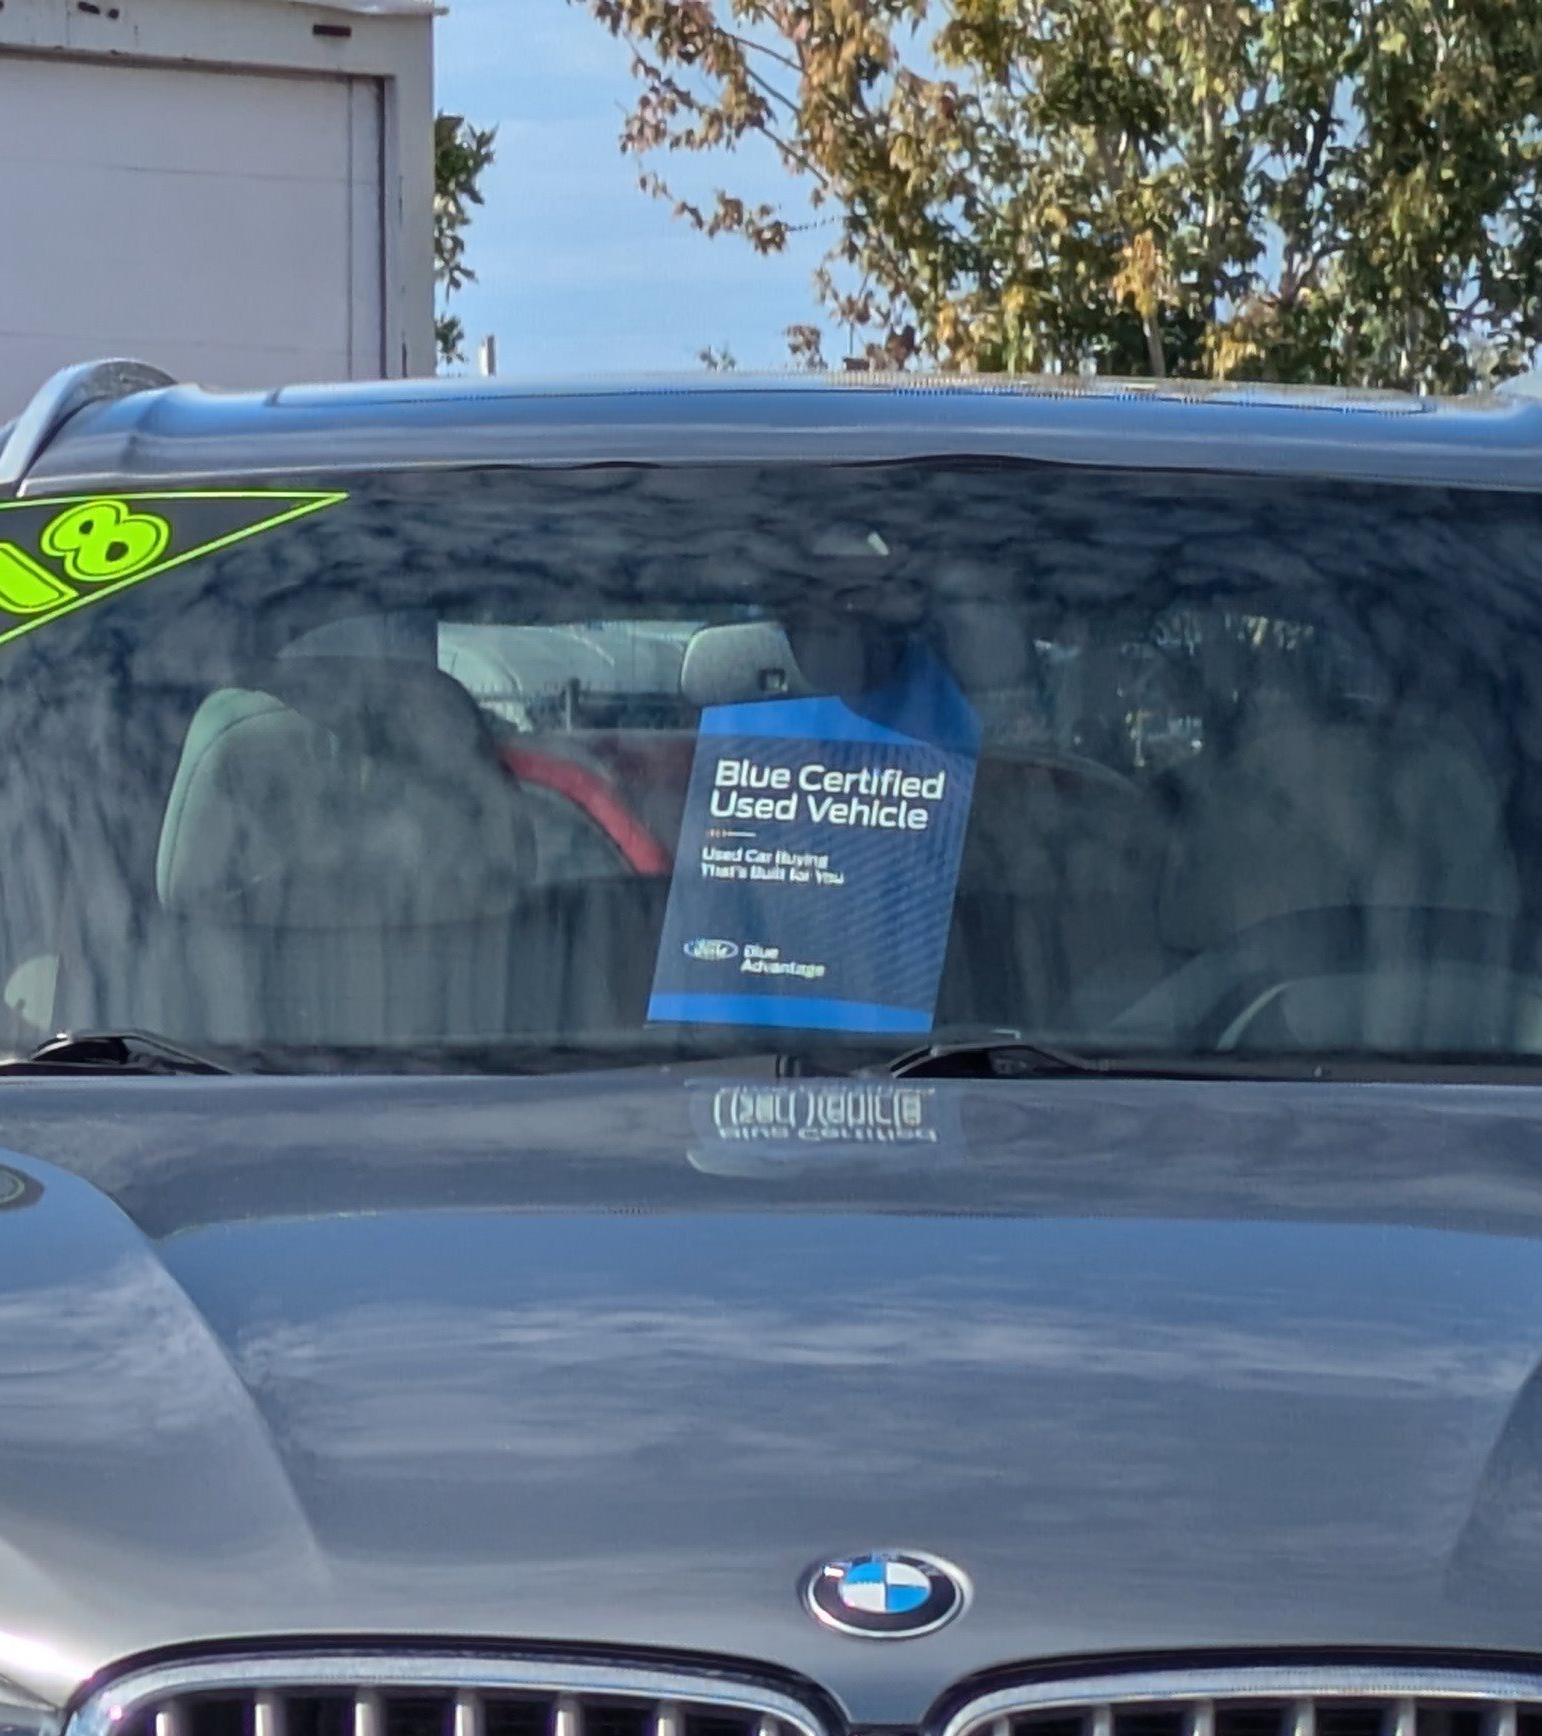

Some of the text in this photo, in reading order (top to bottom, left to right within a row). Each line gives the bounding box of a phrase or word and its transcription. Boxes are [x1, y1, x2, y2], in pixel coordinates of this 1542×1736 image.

[715, 759, 946, 800] Blue Certified
[709, 789, 929, 830] Used Vehicle
